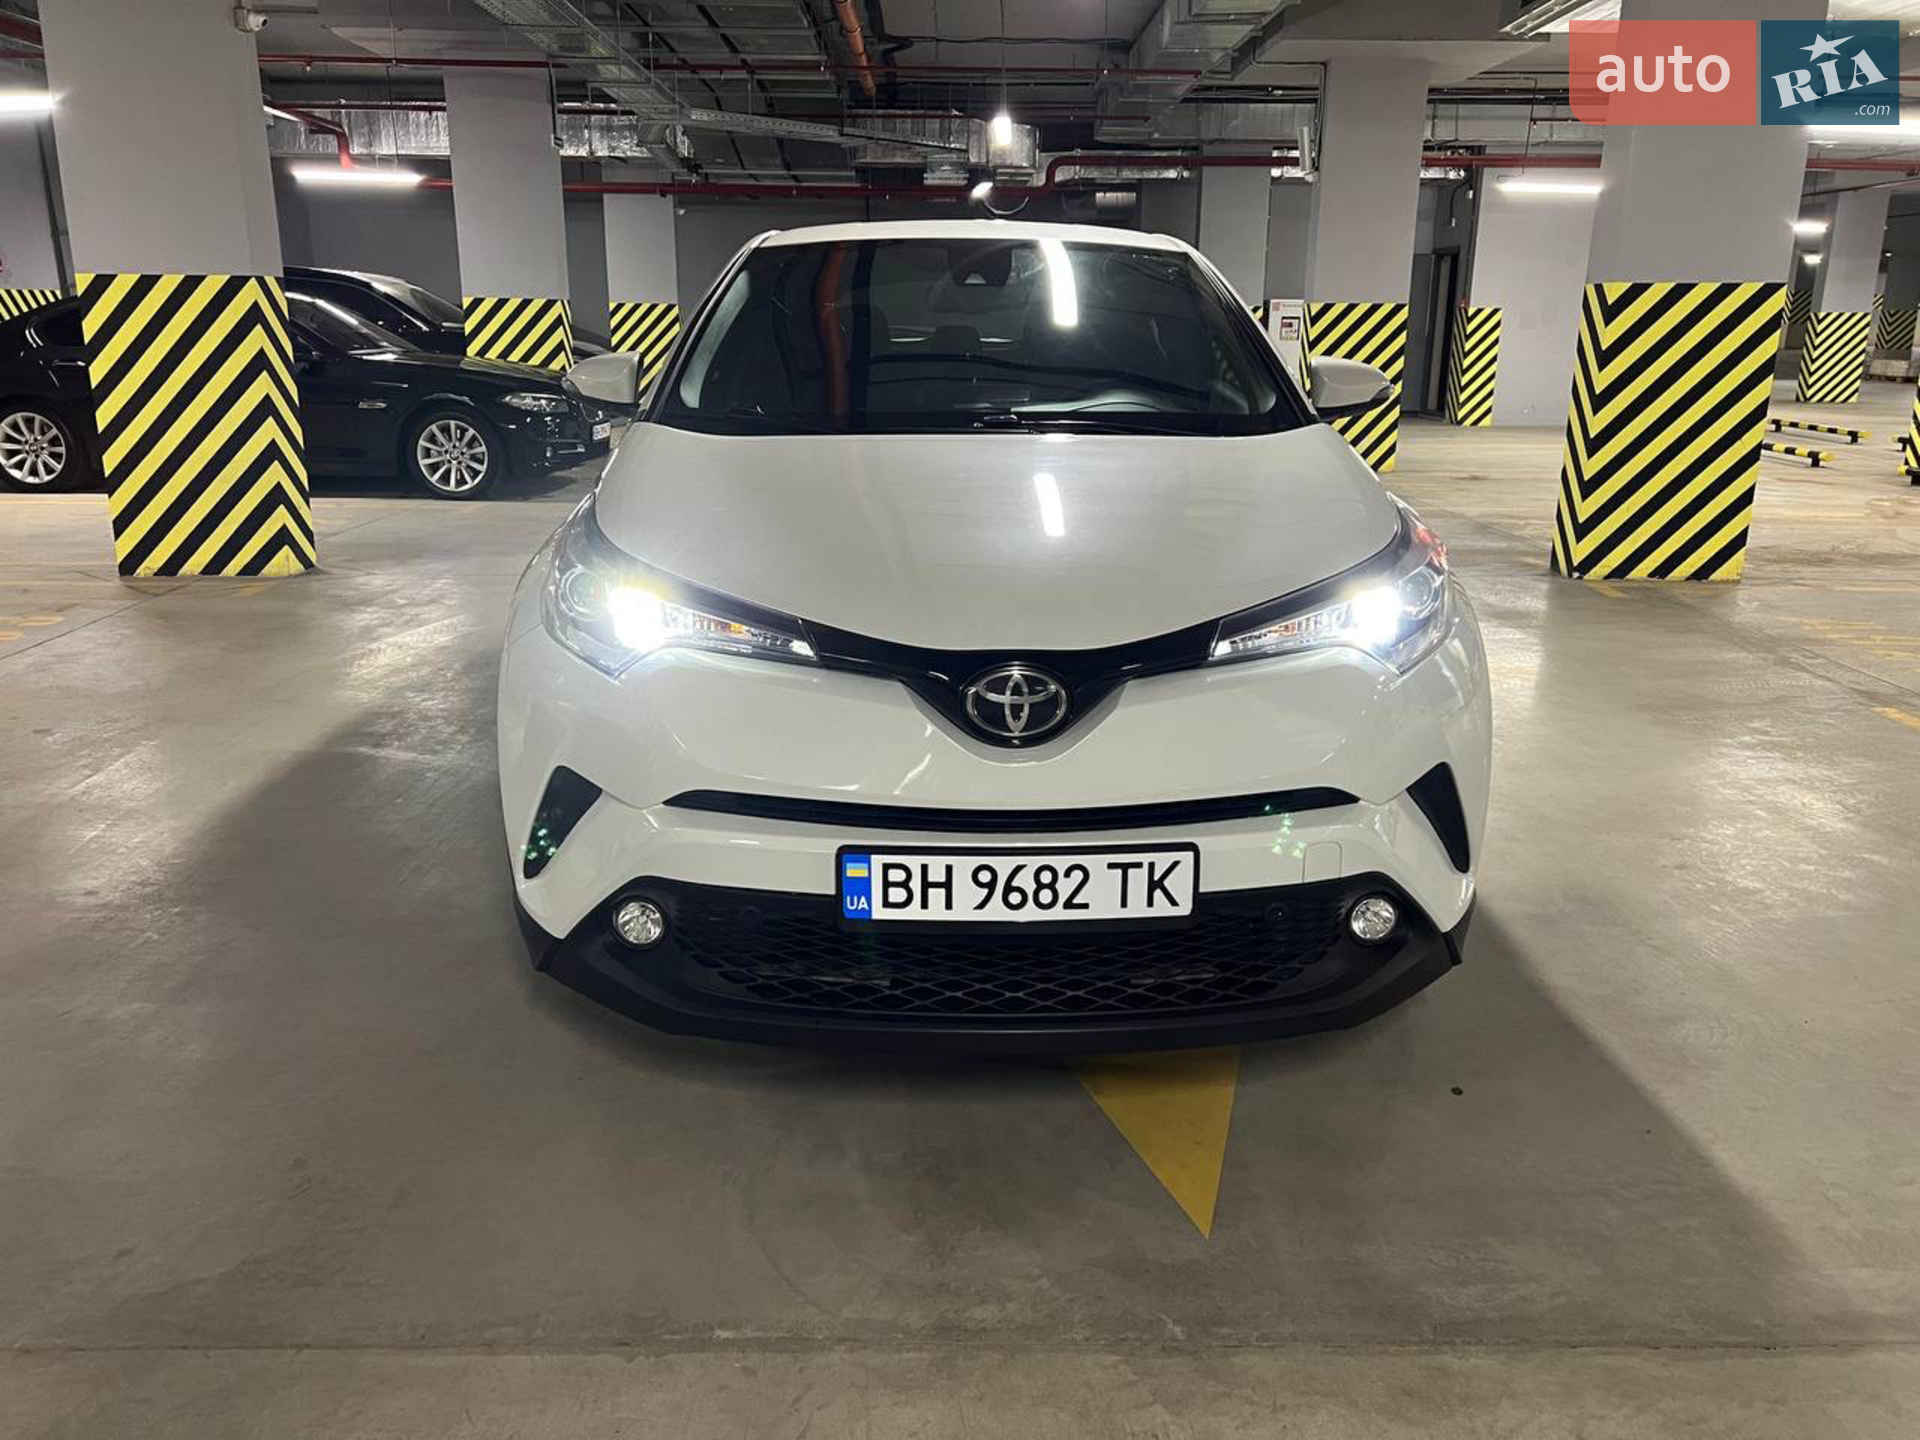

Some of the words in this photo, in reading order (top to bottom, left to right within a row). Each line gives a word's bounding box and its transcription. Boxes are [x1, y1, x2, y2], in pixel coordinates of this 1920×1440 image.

[881, 861, 953, 911] BH
[971, 863, 1091, 911] 9682
[1106, 859, 1182, 909] TK
[846, 896, 869, 911] UA
